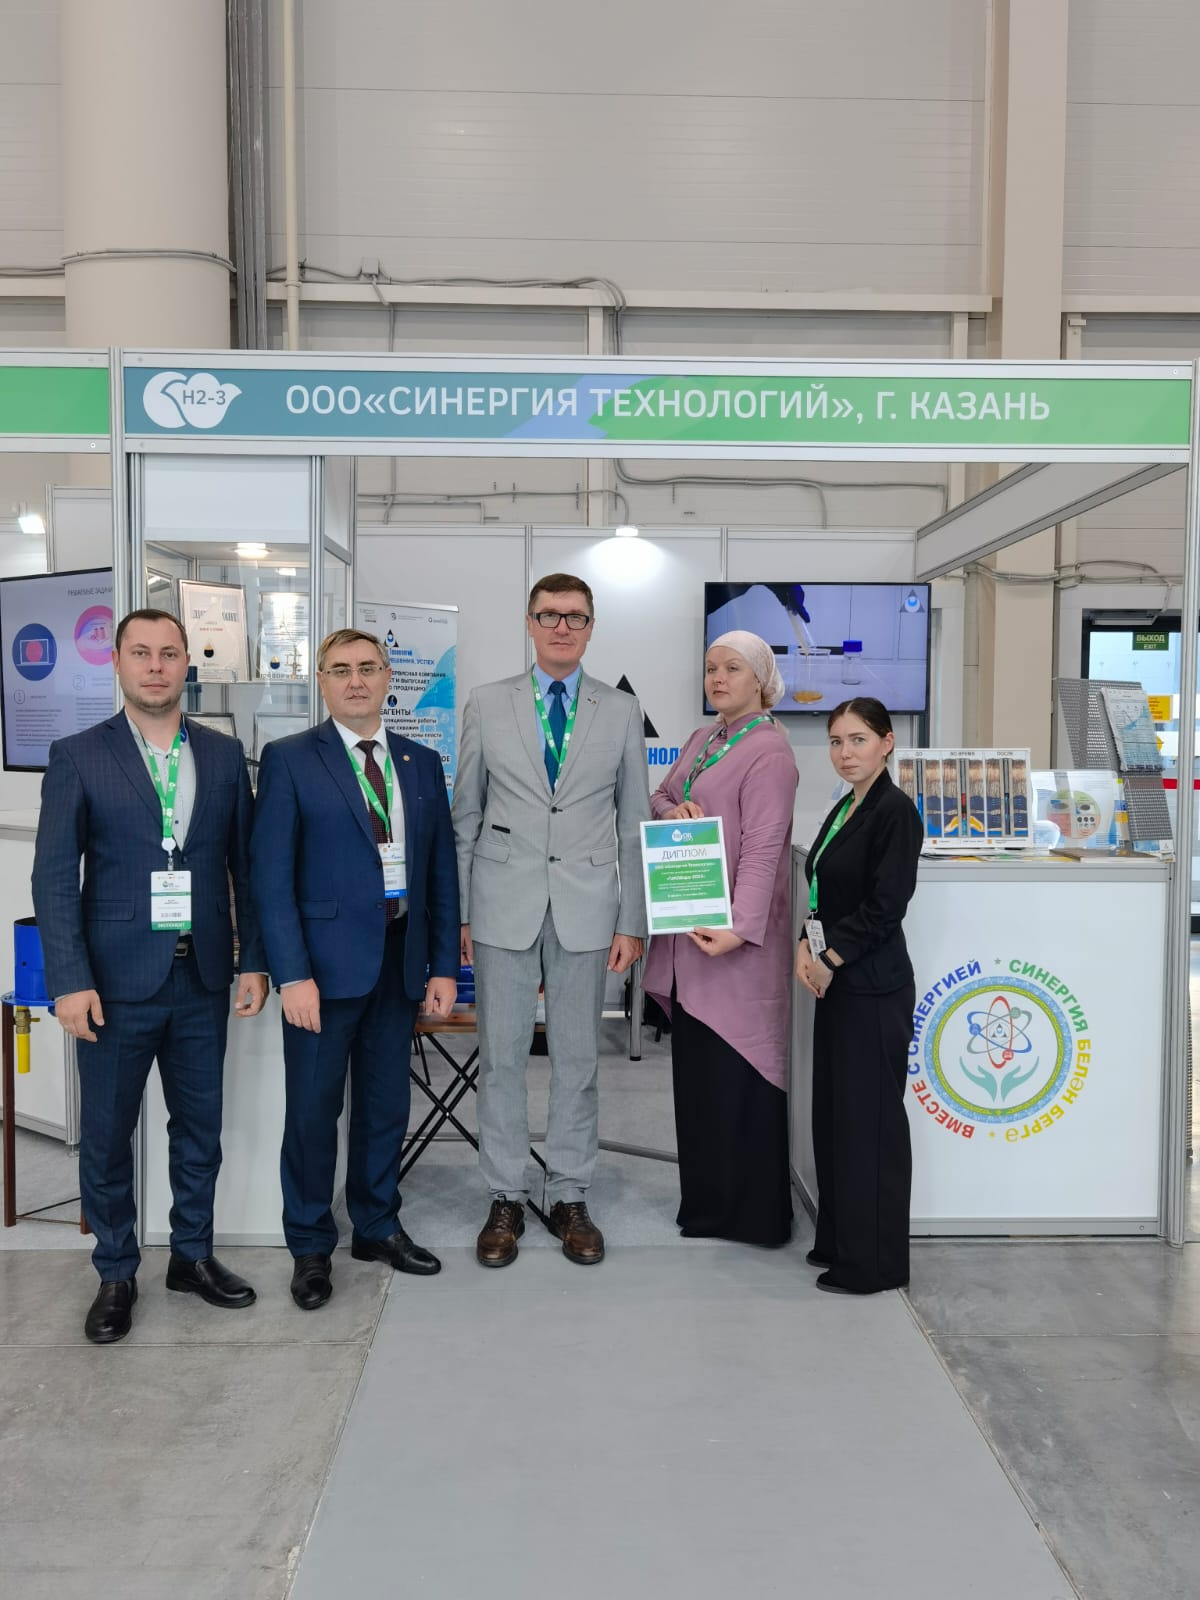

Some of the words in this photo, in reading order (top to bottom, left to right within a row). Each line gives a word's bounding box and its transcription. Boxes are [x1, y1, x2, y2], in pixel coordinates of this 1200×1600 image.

[589, 383, 863, 424] ТЕХНОЛОГИЙ»,
[876, 391, 897, 420] Г.
[910, 391, 1050, 421] КАЗАНЬ
[1136, 634, 1165, 642] ВЫХОД
[380, 708, 411, 716] ЕАГЕНТЫ
[662, 848, 708, 860] ДИПЛОМ
[1009, 959, 1089, 1033] СИНЕРГИЯ
[911, 1079, 975, 1139] ВМЕСТЕ
